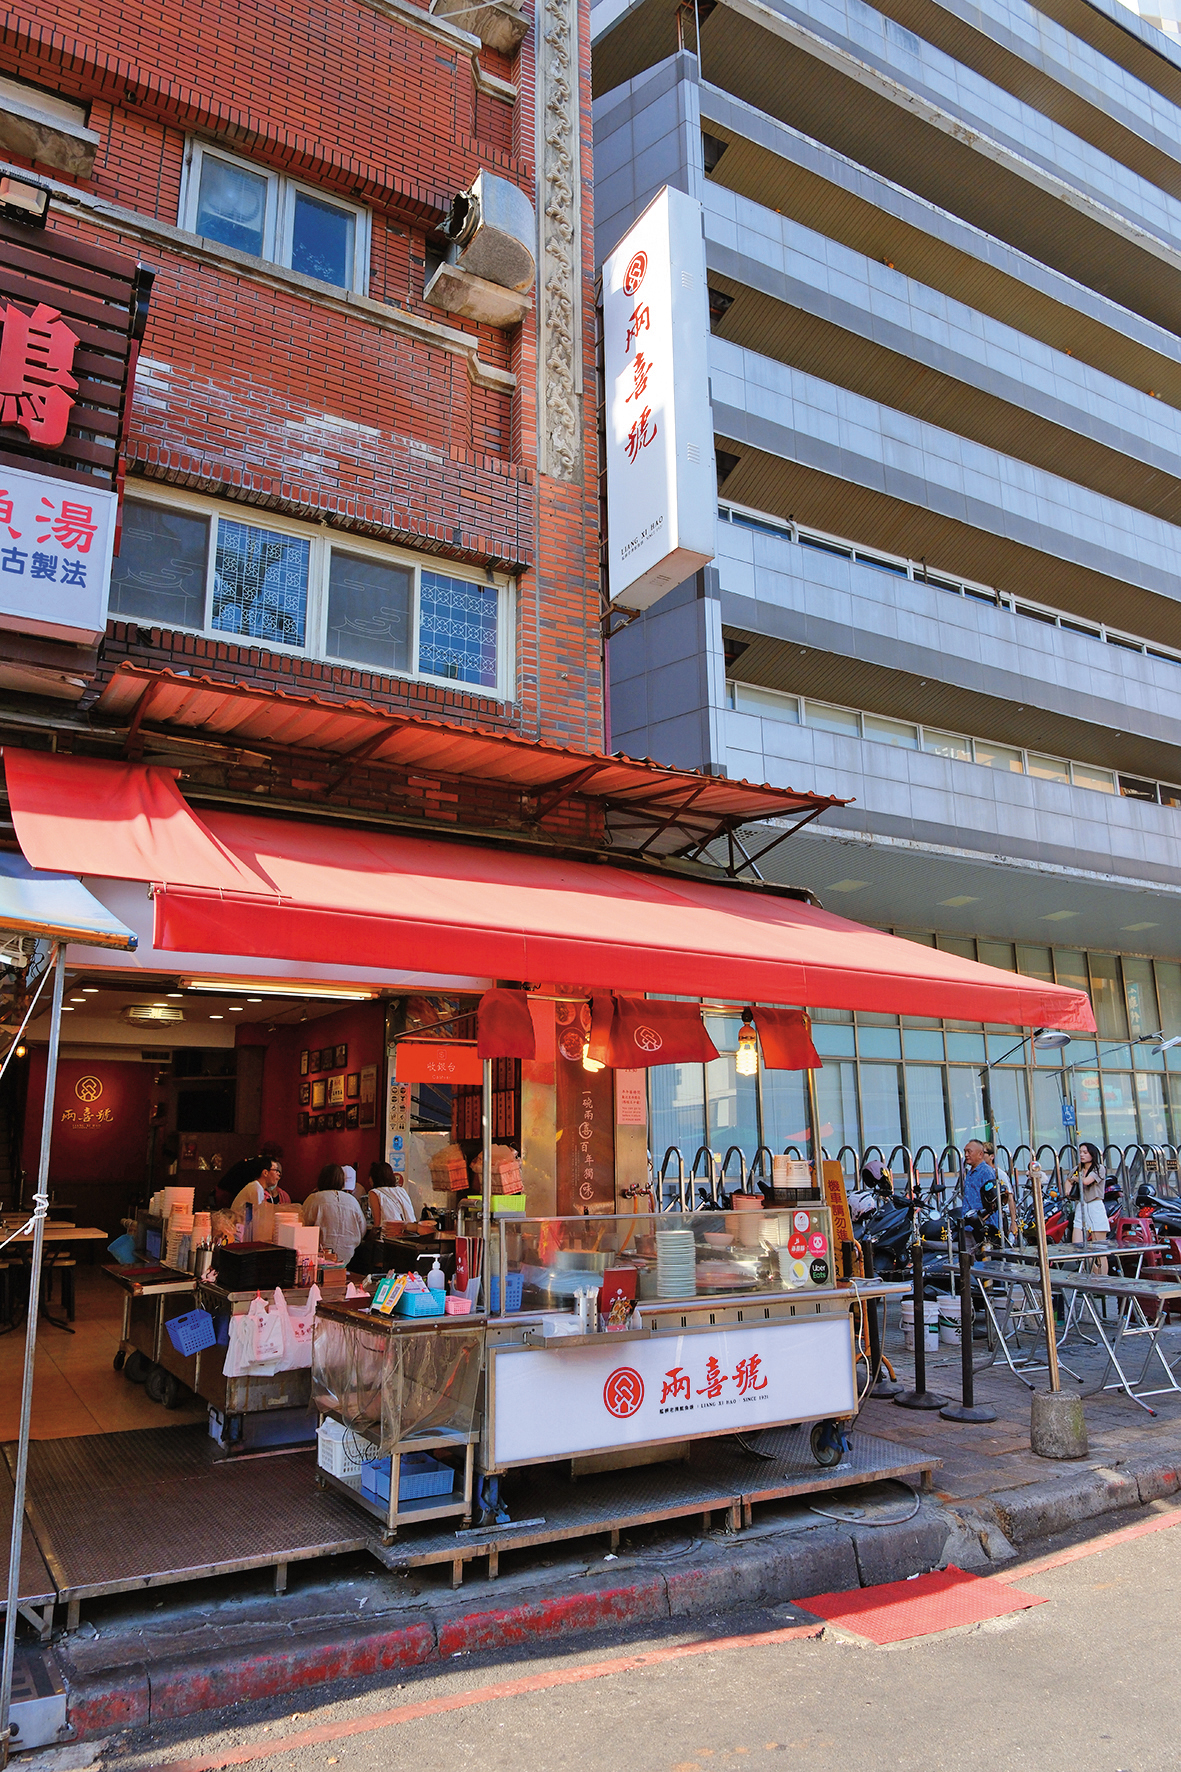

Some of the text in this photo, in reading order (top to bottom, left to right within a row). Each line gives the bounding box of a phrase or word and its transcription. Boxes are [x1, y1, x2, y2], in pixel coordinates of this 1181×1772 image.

[624, 302, 658, 465] 兩喜號
[621, 537, 639, 555] LIANG
[641, 529, 648, 539] XI
[650, 515, 664, 531] HAO
[1, 547, 87, 588] 古製法
[427, 1062, 456, 1073] 收銀台
[61, 1107, 114, 1122] 兩喜號
[827, 1180, 850, 1243] 機車請勿進
[659, 1353, 768, 1405] 兩喜號
